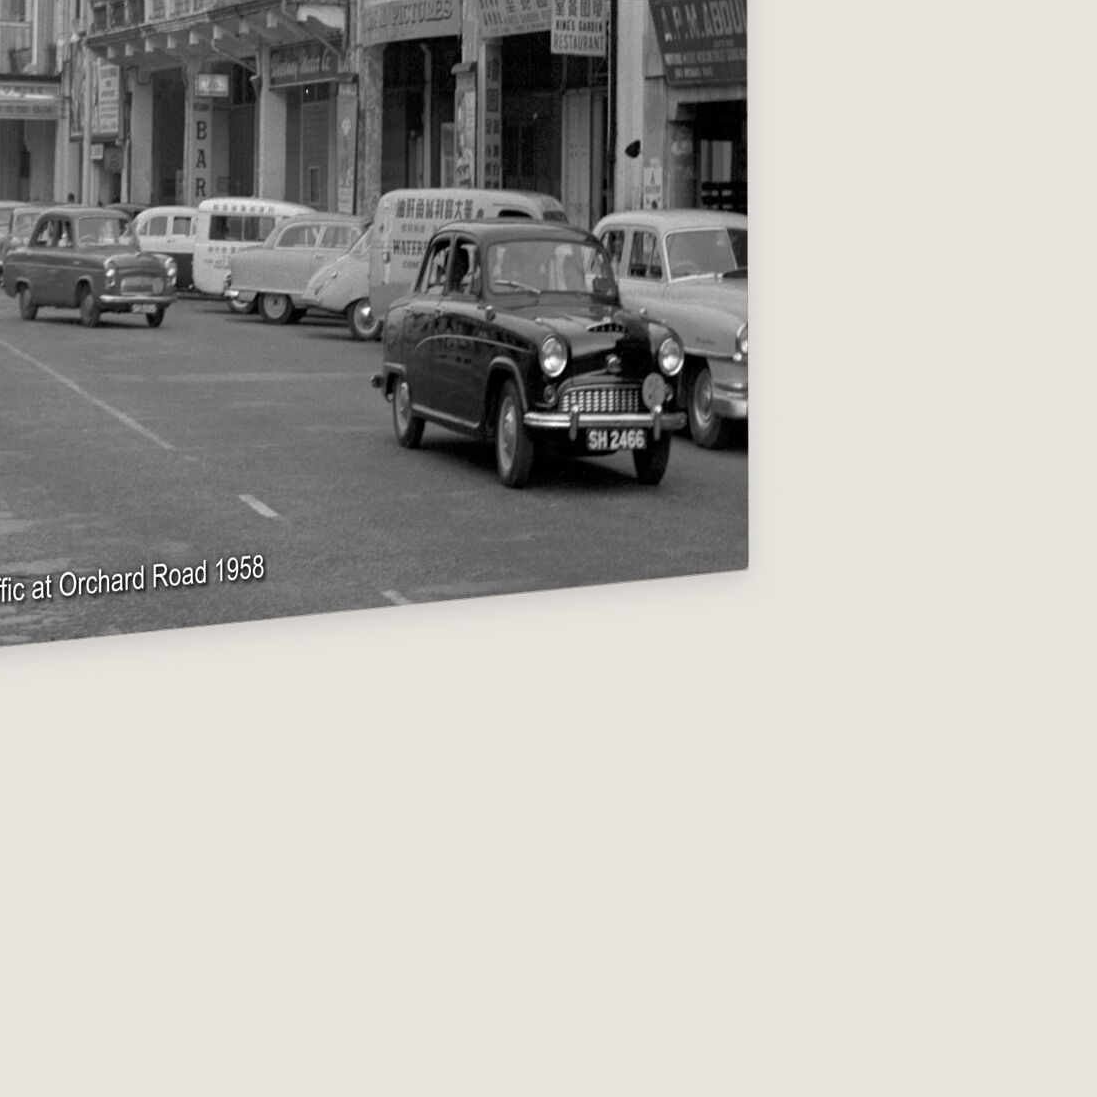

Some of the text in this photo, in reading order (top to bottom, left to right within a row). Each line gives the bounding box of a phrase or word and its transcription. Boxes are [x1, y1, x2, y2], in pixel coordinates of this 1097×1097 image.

[390, 0, 453, 26] PICTURES
[579, 20, 603, 33] GARDEN
[553, 33, 604, 52] RESTAURANT
[195, 120, 207, 197] BAR
[588, 429, 645, 450] SH 2466
